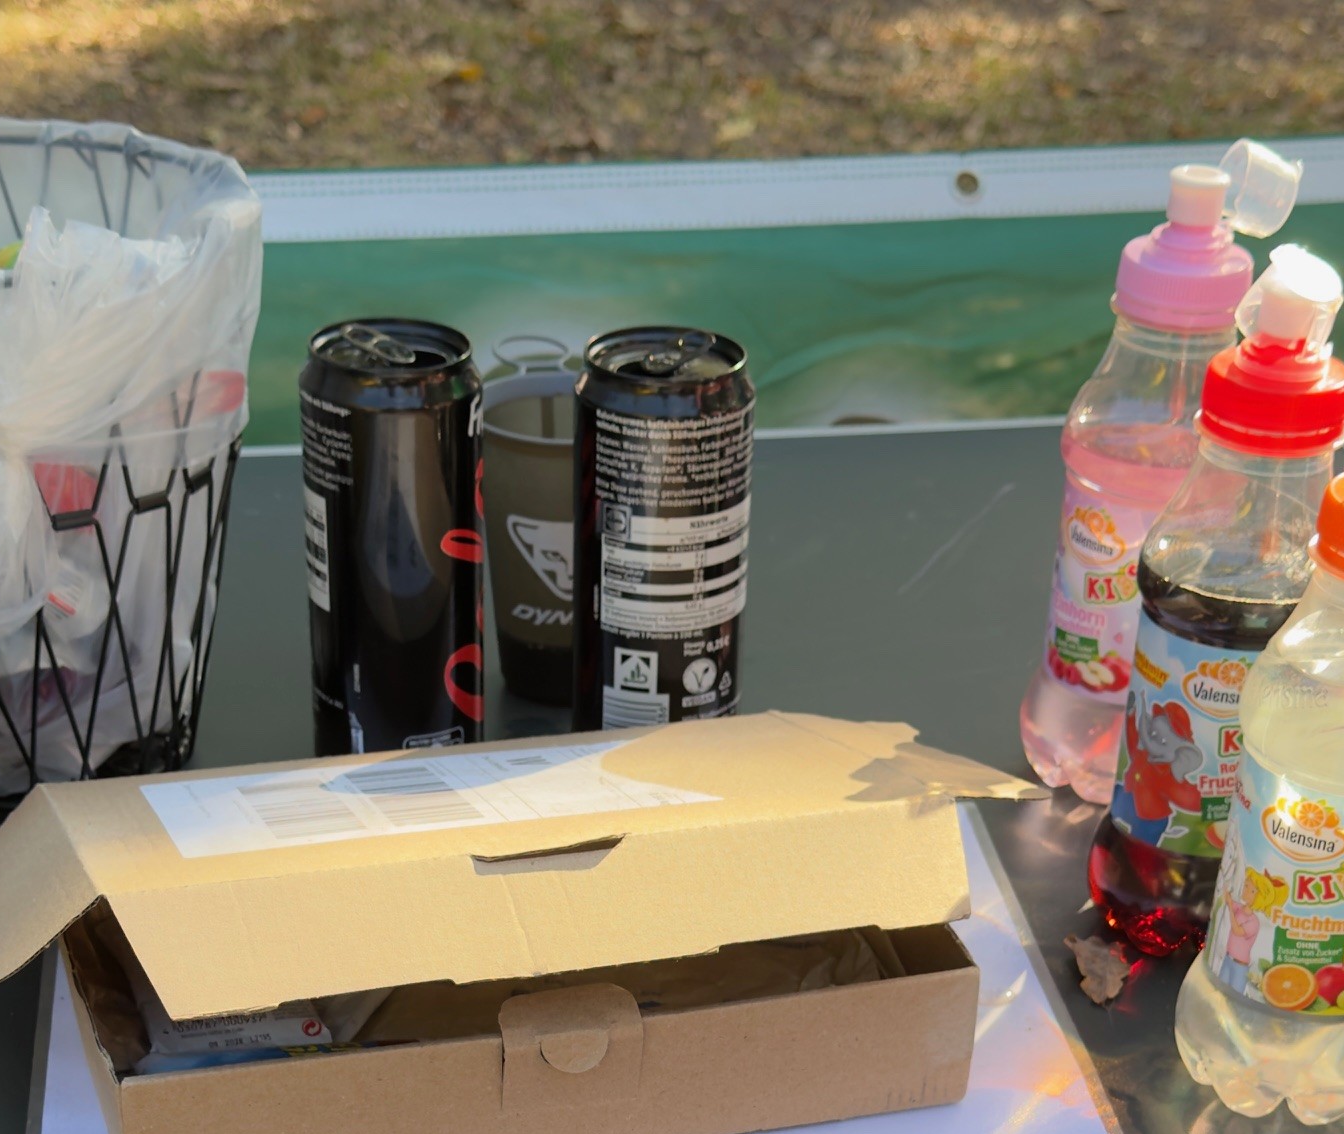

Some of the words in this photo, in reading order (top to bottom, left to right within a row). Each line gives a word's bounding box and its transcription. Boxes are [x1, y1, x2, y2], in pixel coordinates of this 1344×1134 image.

[510, 603, 574, 626] DYN
[1193, 682, 1240, 705] Valensi
[1271, 818, 1337, 854] Valensina
[1296, 941, 1320, 950] OHNE
